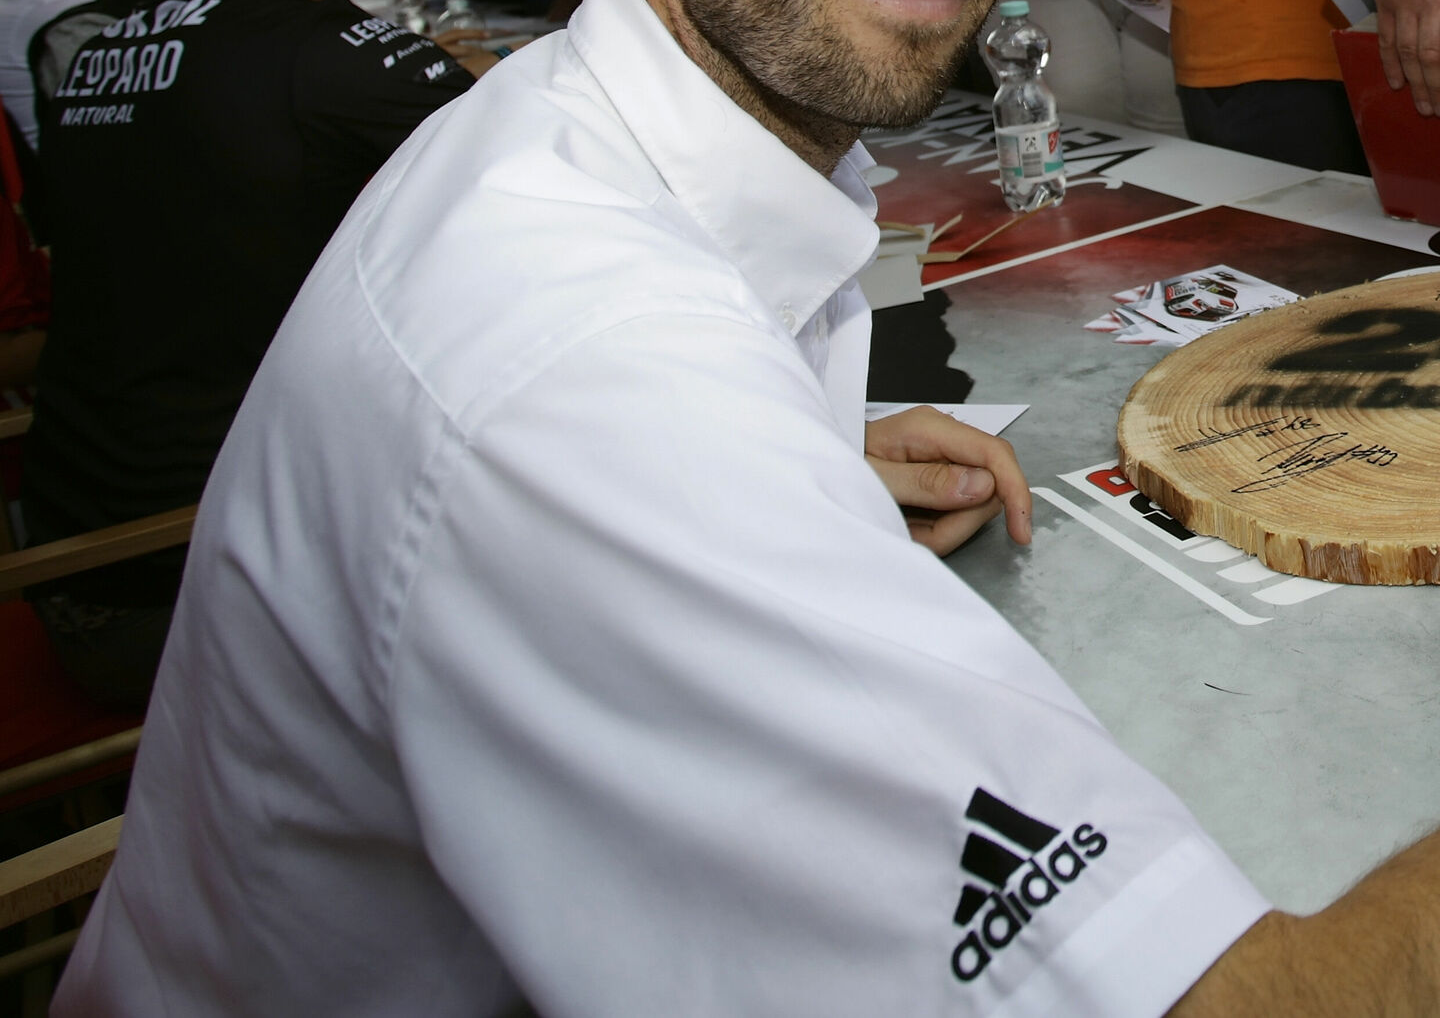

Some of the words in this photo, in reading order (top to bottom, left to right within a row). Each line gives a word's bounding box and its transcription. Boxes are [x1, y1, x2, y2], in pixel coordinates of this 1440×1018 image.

[56, 39, 185, 98] LEOPARD
[61, 104, 135, 126] NATURAL
[951, 823, 1108, 982] adidas
